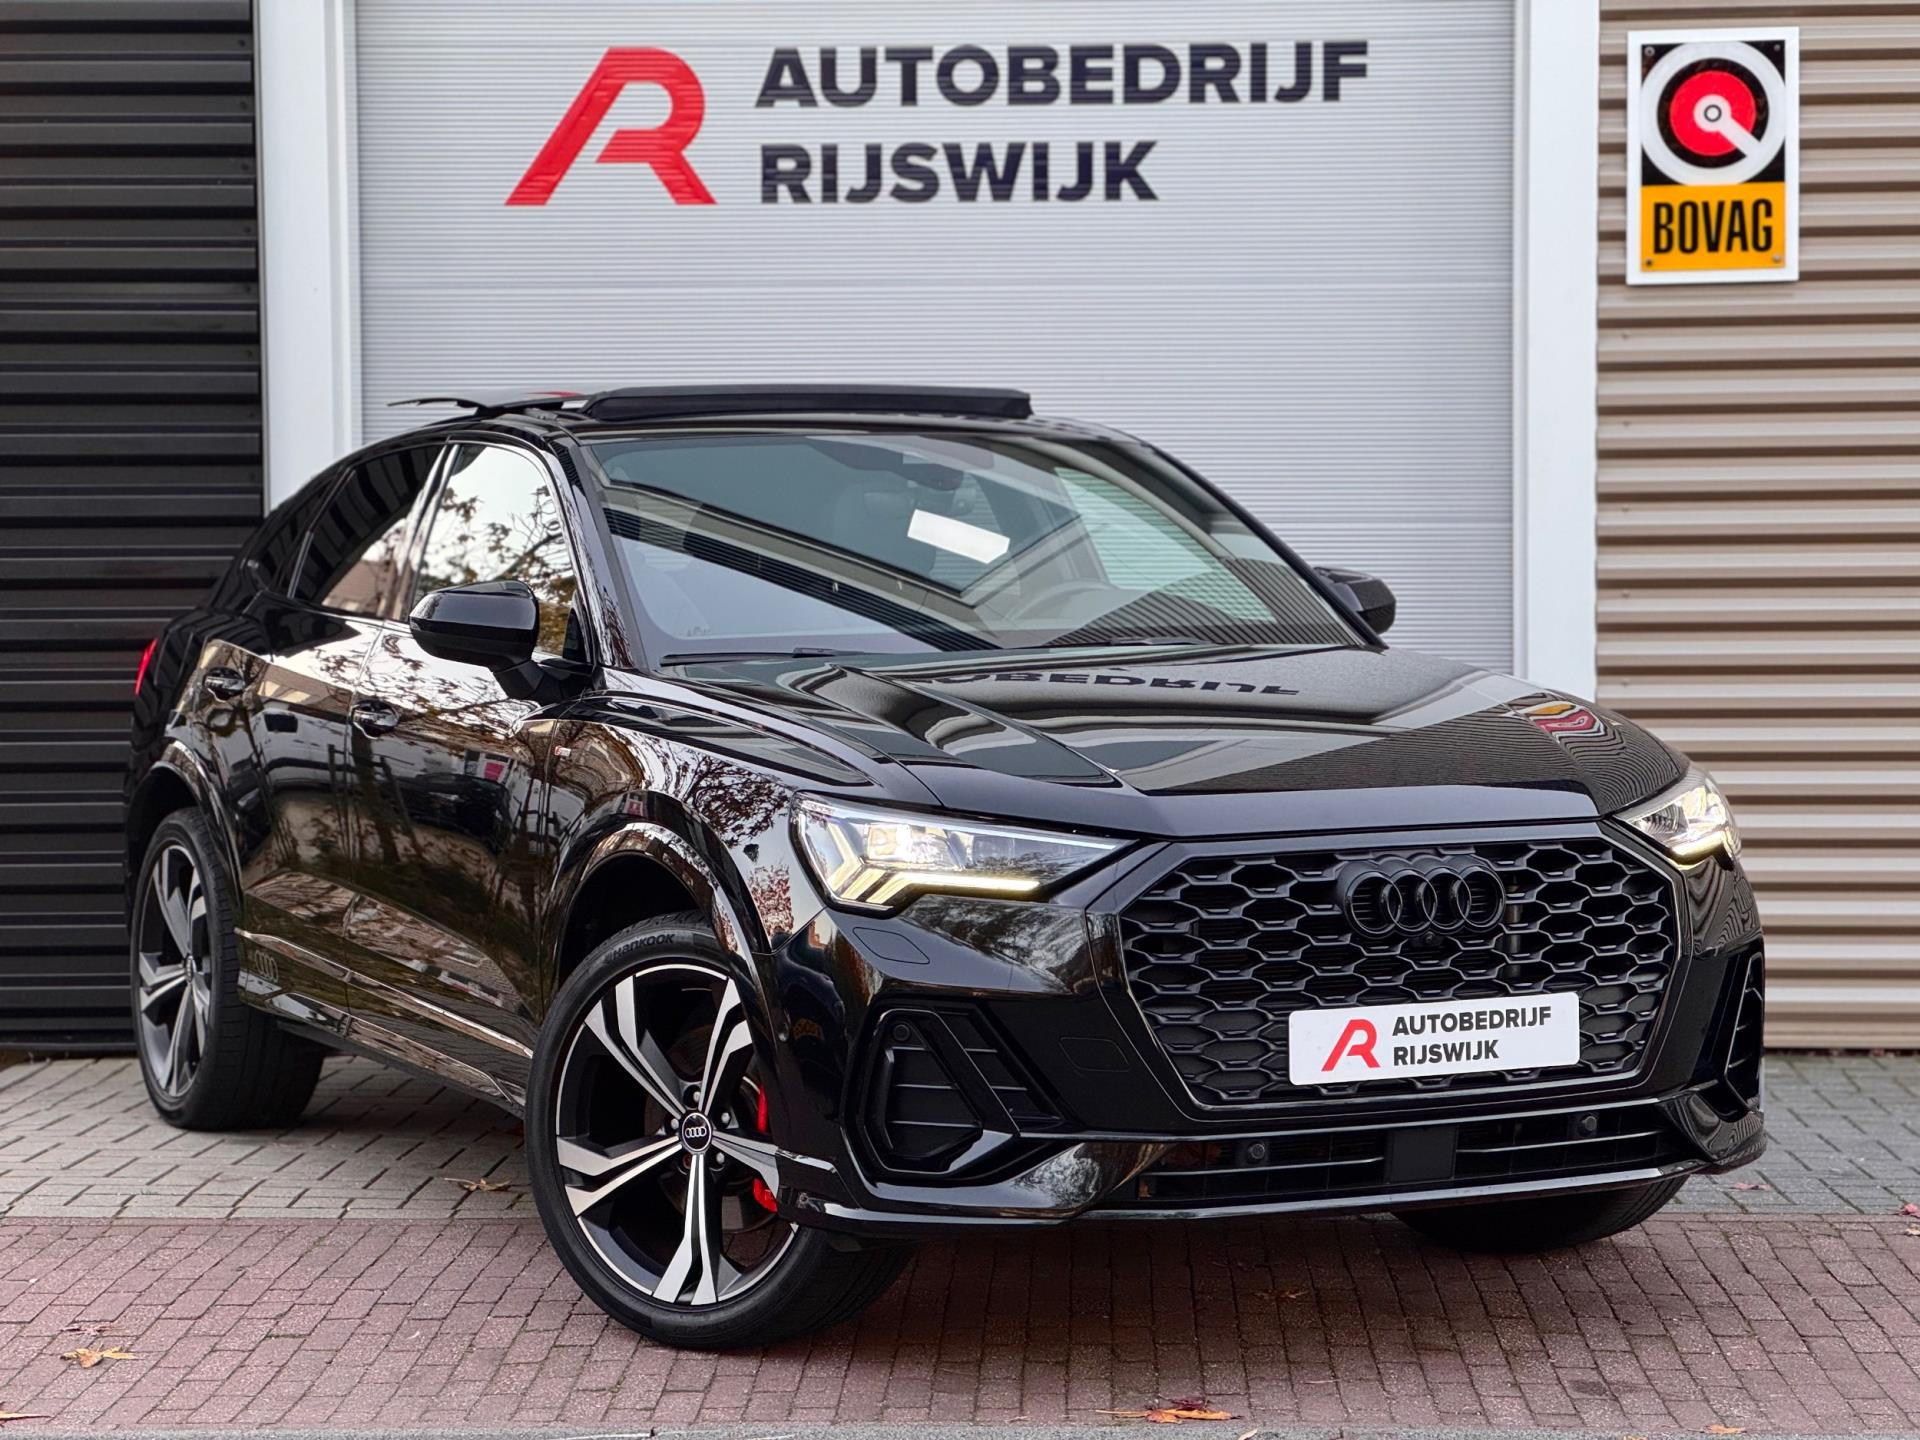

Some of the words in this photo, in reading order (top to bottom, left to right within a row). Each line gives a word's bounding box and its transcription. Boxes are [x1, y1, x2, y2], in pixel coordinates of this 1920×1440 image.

[755, 41, 1368, 108] AUTOBEDRIJF
[761, 141, 1158, 204] RIJSWIJK
[1653, 198, 1773, 255] BOVAG
[1392, 1006, 1551, 1036] AUTOBEDRIJF
[1393, 1039, 1499, 1066] RIJSWIJK
